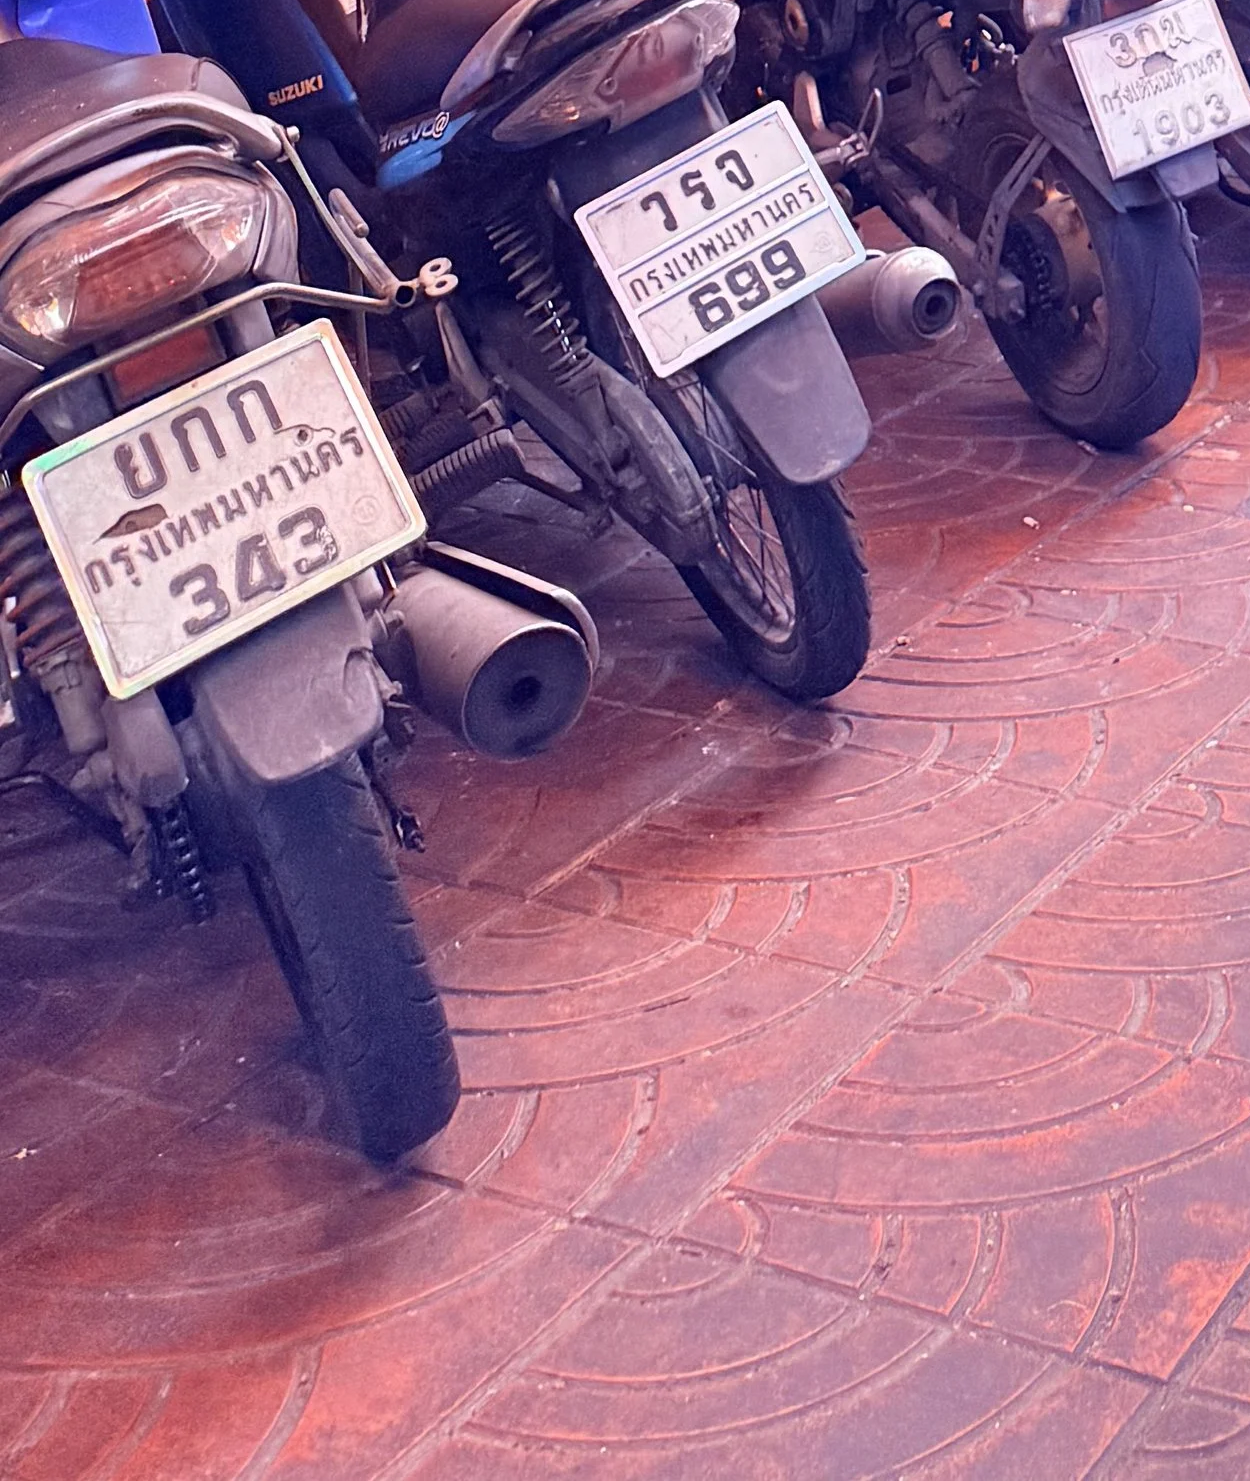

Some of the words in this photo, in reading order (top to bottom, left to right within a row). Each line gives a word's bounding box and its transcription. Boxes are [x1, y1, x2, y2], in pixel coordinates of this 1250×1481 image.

[267, 74, 324, 107] SUZUKI
[1133, 92, 1231, 155] 1903
[629, 183, 816, 302] กรุงเทพมหานคร
[688, 240, 807, 332] 699
[114, 378, 283, 499] ยกก
[84, 427, 365, 595] กรุงเทพมหานคร
[169, 505, 341, 636] 343
